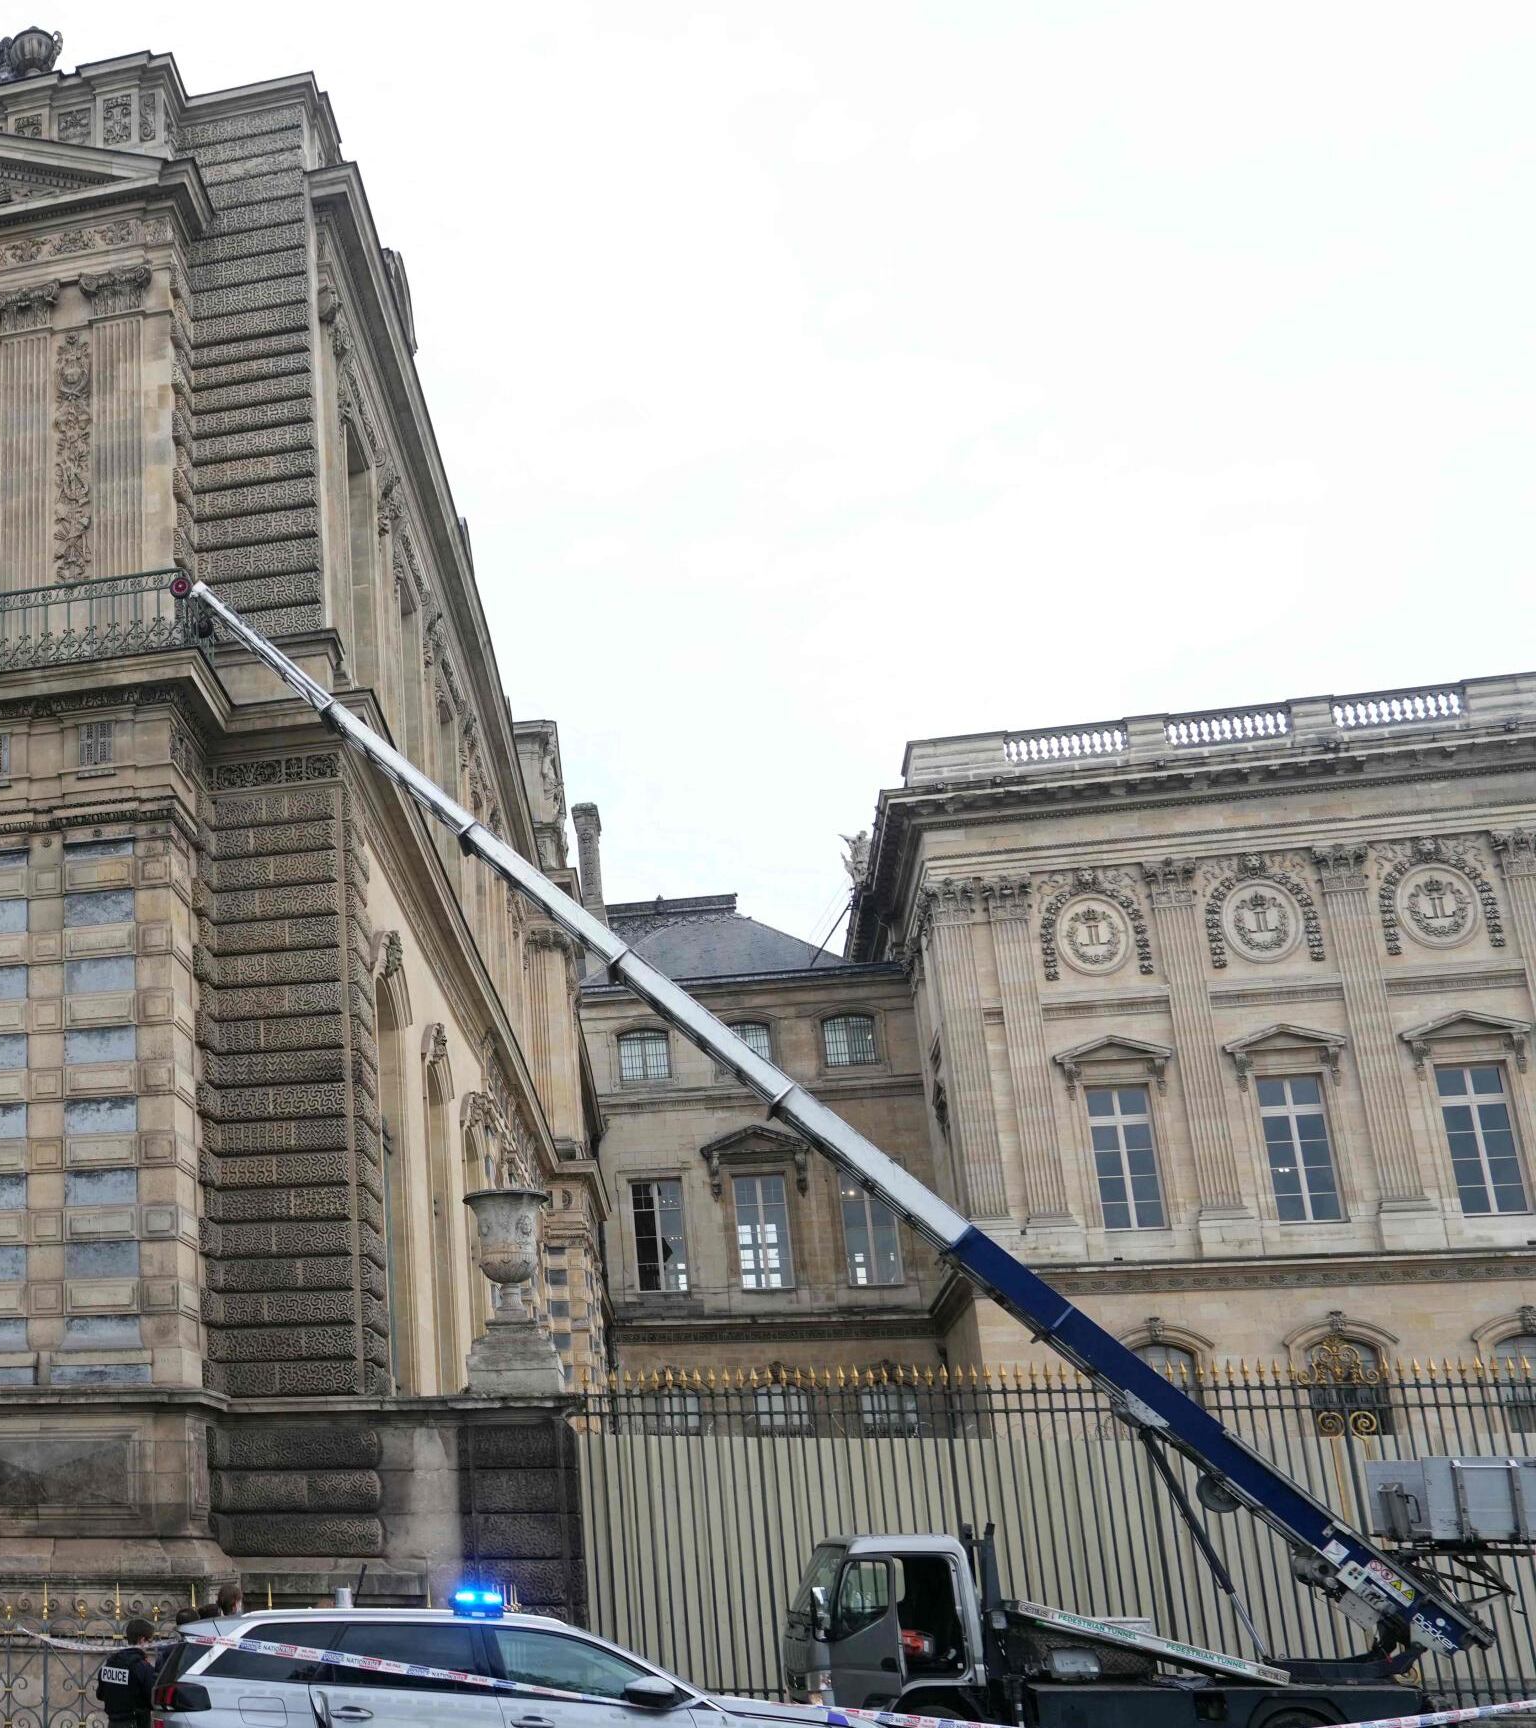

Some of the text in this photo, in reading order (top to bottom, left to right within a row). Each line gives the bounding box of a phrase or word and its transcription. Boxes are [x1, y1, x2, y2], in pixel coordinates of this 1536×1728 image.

[1058, 1613, 1105, 1633] PEDESTRIAN
[1108, 1627, 1137, 1640] TUNNEL
[1412, 1613, 1458, 1649] Böcker
[1166, 1642, 1214, 1660] PEDESTRIAN
[1217, 1655, 1247, 1669] TUNNEL
[102, 1668, 127, 1682] POLICE
